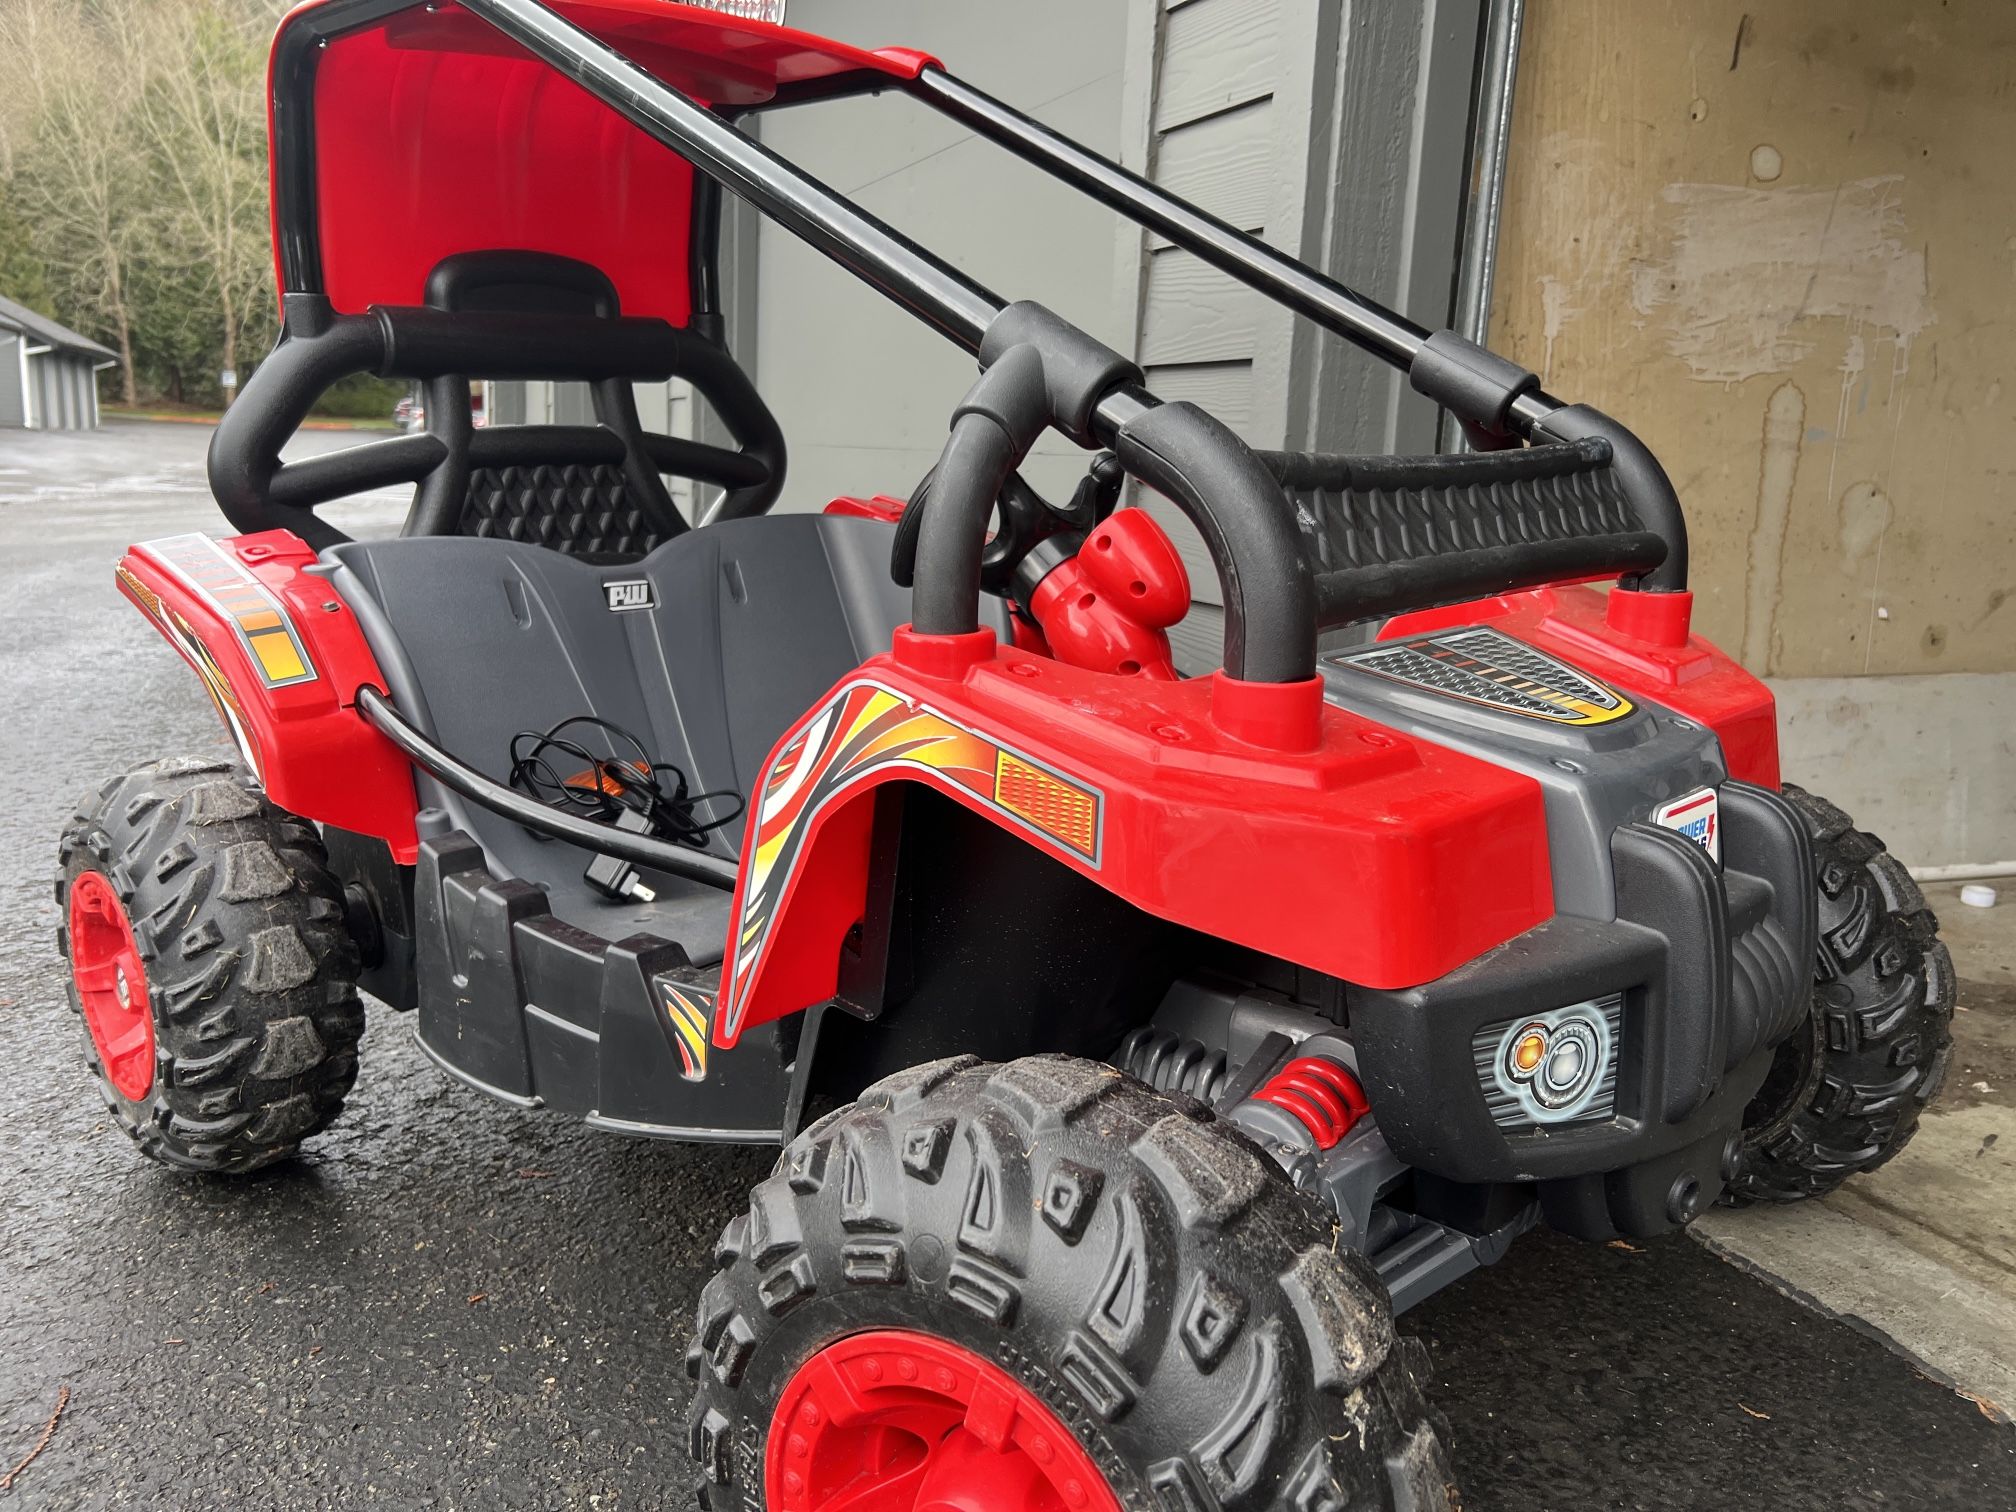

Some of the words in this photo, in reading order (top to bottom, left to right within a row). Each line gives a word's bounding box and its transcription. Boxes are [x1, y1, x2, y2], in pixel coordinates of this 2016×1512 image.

[608, 583, 650, 608] PW
[1677, 816, 1707, 838] WER
[998, 1340, 1127, 1478] ULTIMATE
